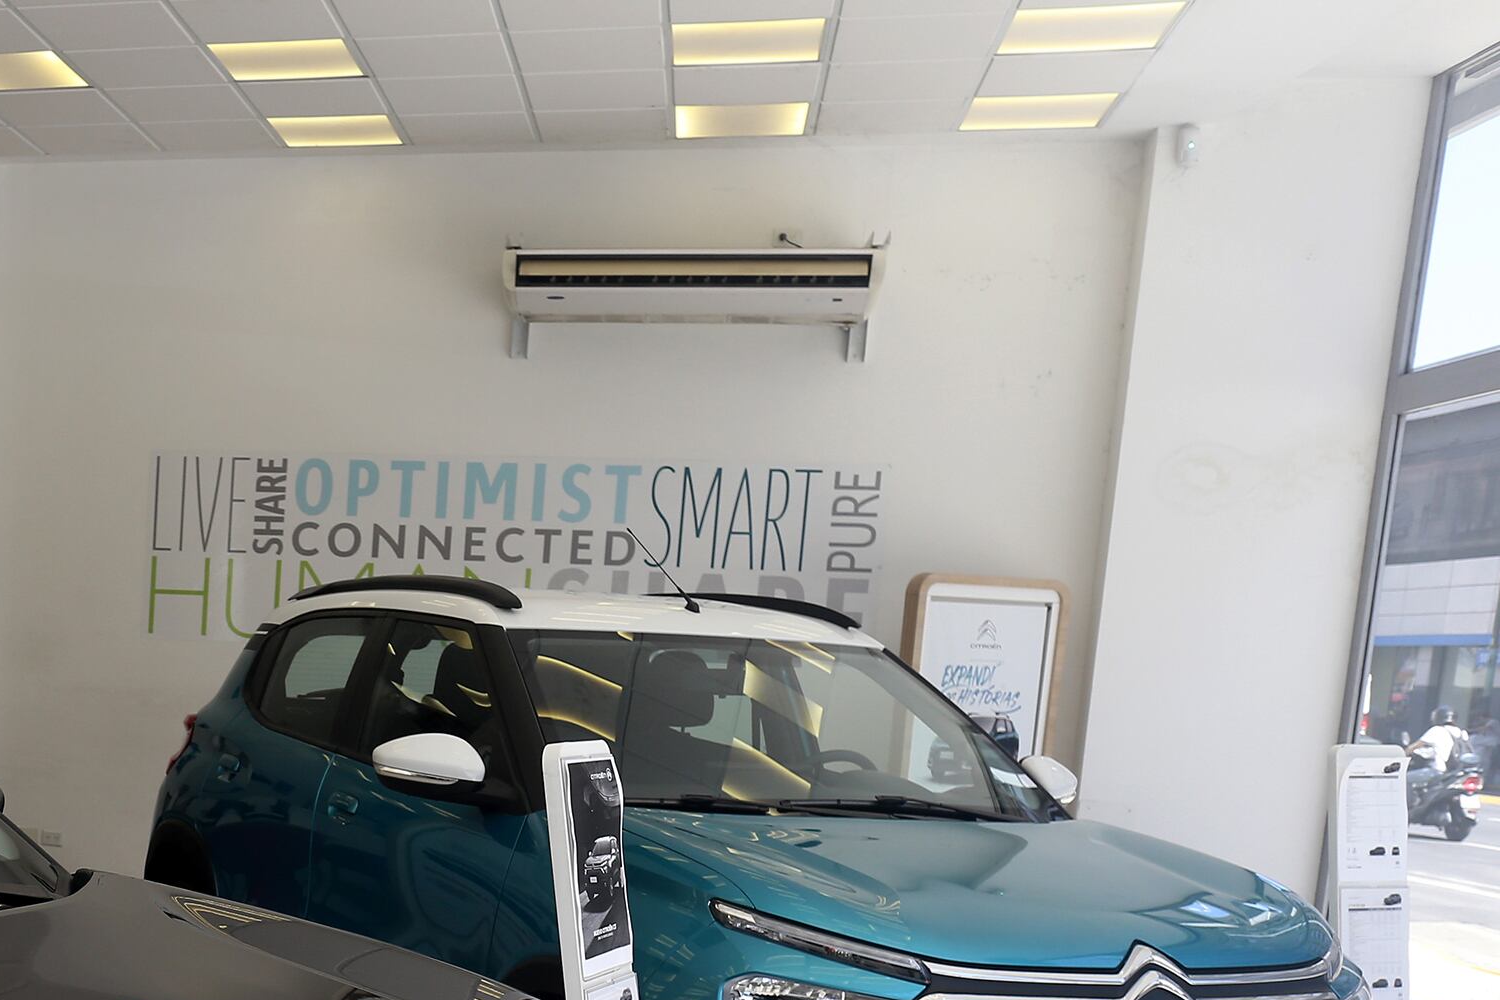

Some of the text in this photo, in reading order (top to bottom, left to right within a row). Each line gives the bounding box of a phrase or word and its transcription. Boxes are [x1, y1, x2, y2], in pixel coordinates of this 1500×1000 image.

[152, 455, 251, 554] LIVE
[252, 457, 288, 556] SHARE
[294, 457, 643, 525] OPTIMIST
[643, 465, 823, 573] SMART
[825, 470, 882, 574] PURE
[291, 521, 637, 567] CONNECTED
